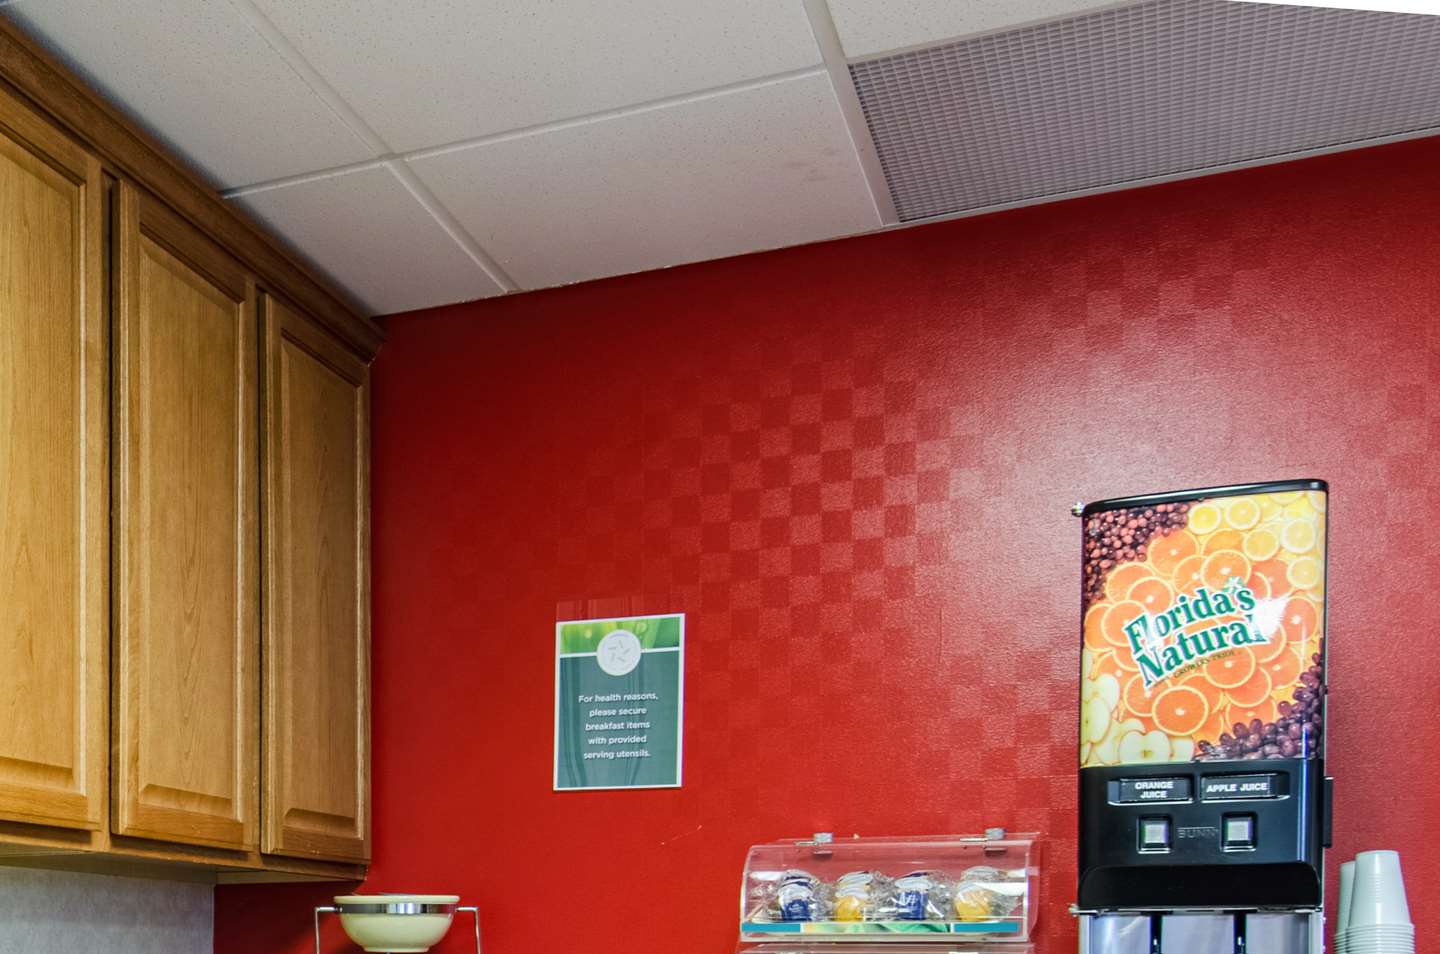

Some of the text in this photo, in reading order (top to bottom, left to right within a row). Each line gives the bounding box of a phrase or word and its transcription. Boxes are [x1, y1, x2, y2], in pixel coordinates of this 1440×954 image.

[578, 695, 593, 703] For
[595, 693, 621, 702] health
[589, 707, 647, 717] please secure
[585, 721, 651, 731] breakfast items
[588, 735, 647, 746] with provided
[583, 749, 652, 760] serving utensils.
[1134, 781, 1174, 790] ORANGE
[1206, 782, 1269, 793] APPLE JUICE
[1140, 790, 1168, 799] JUICE
